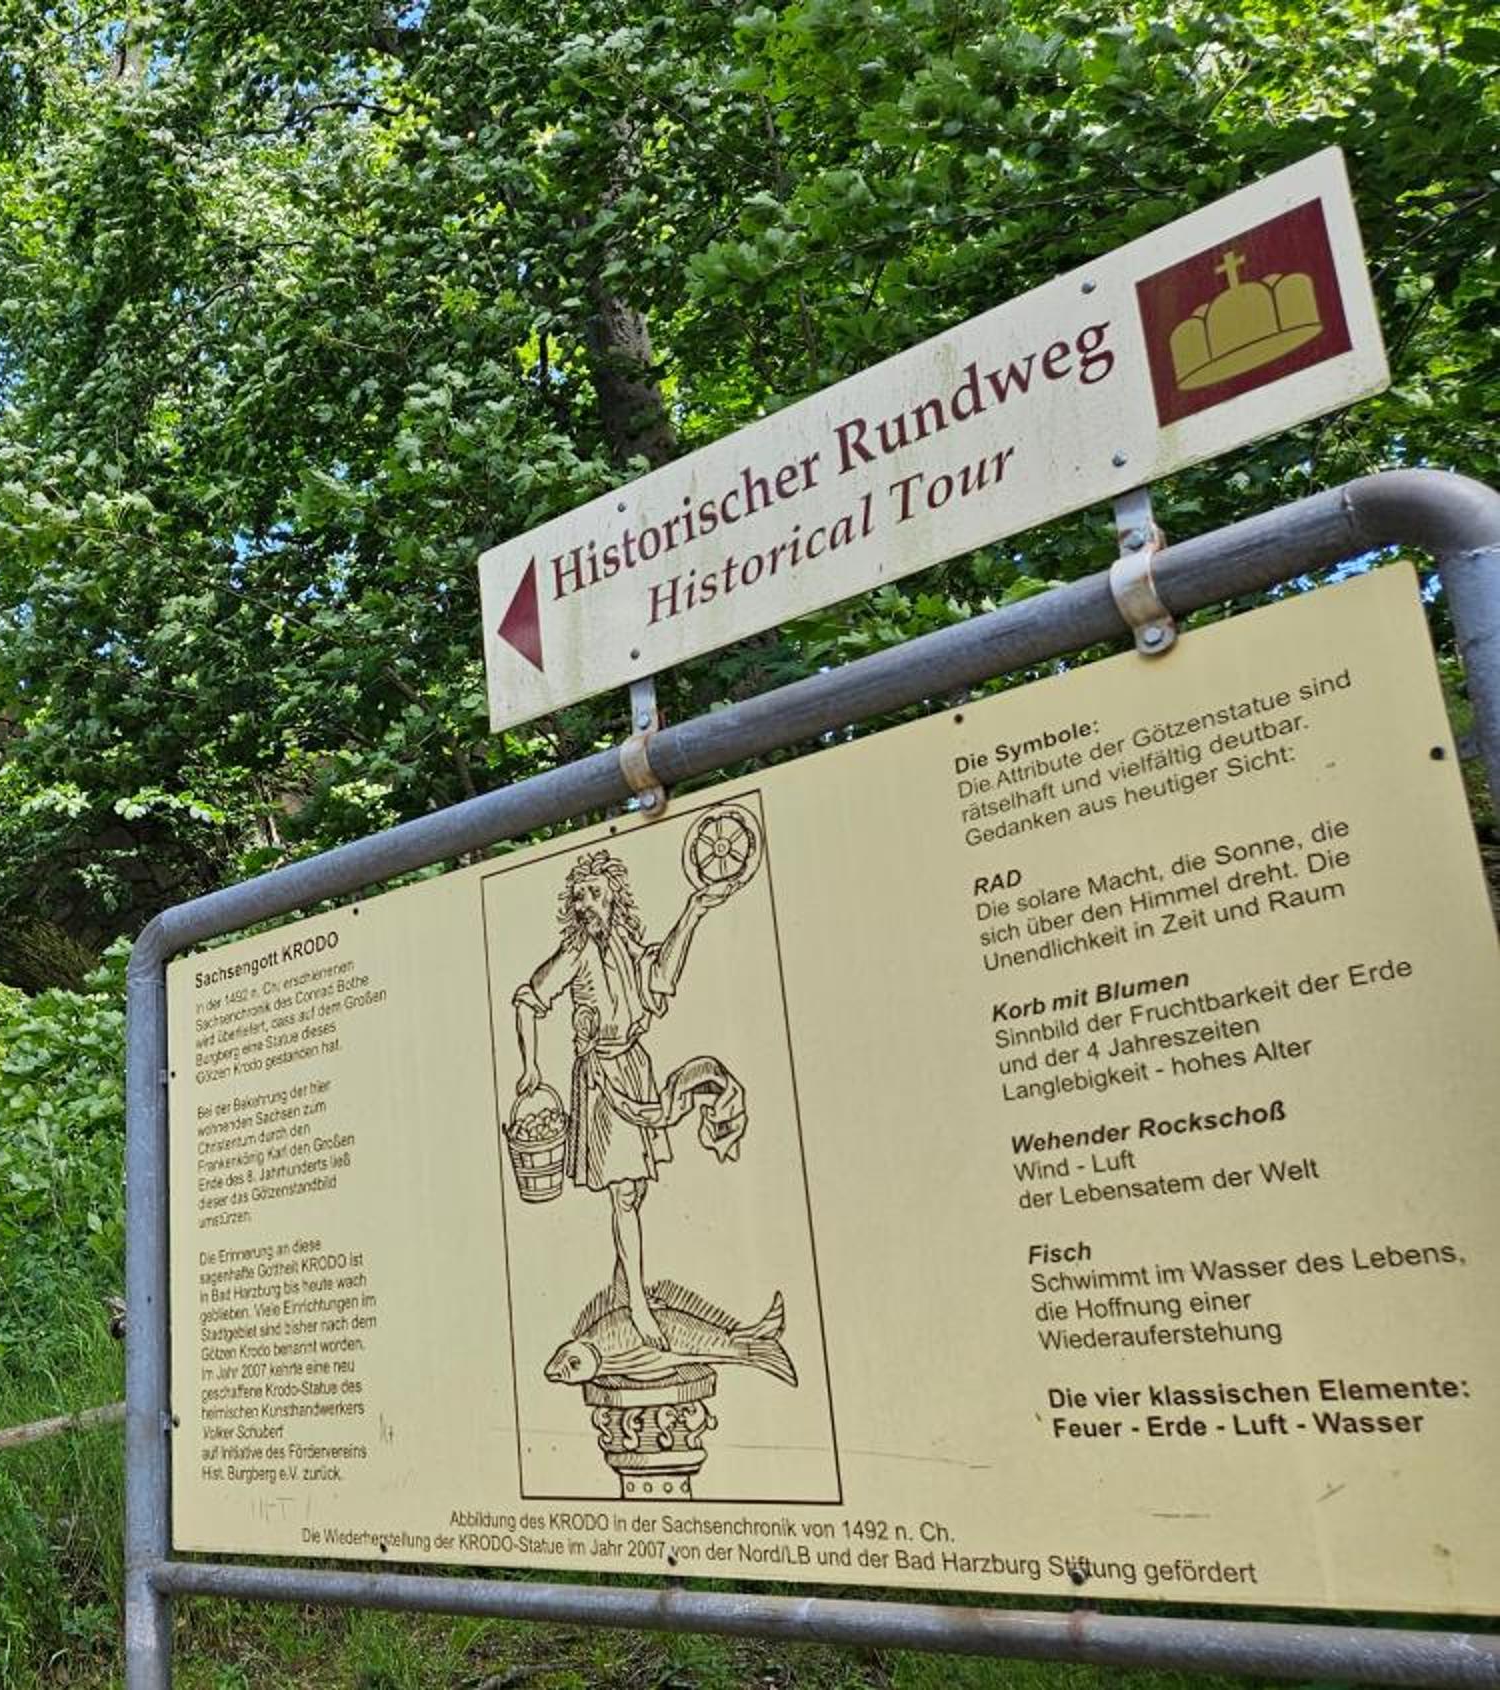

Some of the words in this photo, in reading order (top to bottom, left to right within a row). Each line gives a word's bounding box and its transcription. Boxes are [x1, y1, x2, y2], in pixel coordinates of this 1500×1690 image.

[549, 450, 820, 601] Historischer
[833, 320, 1115, 476] Rundweg
[647, 491, 874, 626] Historical
[889, 445, 1015, 524] Tour
[954, 753, 988, 775] Die
[995, 720, 1099, 763] Symbole:
[957, 777, 991, 799] Die
[996, 751, 1083, 789] Attribute
[1088, 738, 1125, 761] der
[1131, 691, 1291, 748] Götzenstatue
[1298, 668, 1351, 701] sind
[961, 781, 1057, 823] rätselhaft
[1061, 767, 1102, 795] und
[1107, 743, 1203, 782] vielfältig
[1208, 715, 1309, 755] deutbar.
[965, 807, 1071, 847] Gedanken
[1077, 795, 1117, 817] aus
[1123, 767, 1218, 805] heutiger
[1225, 745, 1295, 777] Sicht:
[973, 869, 1022, 896] RAD
[975, 900, 1010, 921] Die
[1016, 885, 1081, 912] solare
[1087, 863, 1164, 895] Macht,
[1171, 853, 1207, 876] die
[1214, 834, 1303, 865] Sonne,
[1311, 820, 1349, 843] die
[979, 922, 1021, 947] sich
[1026, 912, 1074, 936] über
[1080, 902, 1123, 923] den
[1129, 876, 1219, 913] Himmel
[1227, 860, 1298, 892] dreht.
[1306, 849, 1351, 874] Die
[983, 925, 1128, 971] Unendlichkeit
[1133, 921, 1155, 940] in
[1160, 908, 1208, 935] Zeit
[1213, 895, 1260, 923] und
[1267, 882, 1345, 912] Raum
[195, 950, 278, 988] Sachsengott
[282, 931, 338, 962] KRODO
[992, 996, 1046, 1023] Korb
[1051, 988, 1088, 1012] mit
[1095, 972, 1189, 1004] Blumen
[995, 1016, 1079, 1049] Sinnbild
[1086, 1012, 1123, 1033] der
[1129, 979, 1291, 1025] Fruchtbarkeit
[1297, 973, 1340, 995] der
[1347, 959, 1412, 987] Erde
[998, 1051, 1038, 1075] und
[1044, 1047, 1080, 1068] der
[1086, 1041, 1100, 1060] 4
[1107, 1018, 1260, 1057] Jahreszeiten
[1002, 1061, 1149, 1101] Langlebigkeit
[1170, 1050, 1247, 1076] hohes
[1253, 1039, 1312, 1064] Alter
[1011, 1124, 1131, 1154] Wehender
[1138, 1099, 1286, 1139] Rockschoß
[1013, 1156, 1070, 1182] Wind
[1091, 1148, 1137, 1173] Luft
[1018, 1189, 1053, 1209] der
[1059, 1175, 1205, 1205] Lebensatem
[1211, 1167, 1253, 1189] der
[1258, 1157, 1320, 1184] Welt
[1028, 1240, 1091, 1265] Fisch
[1031, 1266, 1151, 1293] Schwimmt
[1155, 1263, 1185, 1284] im
[1189, 1258, 1287, 1281] Wasser
[1295, 1251, 1345, 1275] des
[1351, 1245, 1466, 1270] Lebens,
[361, 1291, 376, 1307] im
[1035, 1300, 1069, 1322] die
[1074, 1296, 1182, 1320] Hoffnung
[1189, 1291, 1252, 1313] einer
[1037, 1320, 1283, 1350] Wiederauferstehung
[1047, 1387, 1087, 1409] Die
[1093, 1386, 1141, 1407] vier
[1148, 1381, 1310, 1407] klassischen
[1317, 1376, 1470, 1401] Elemente:
[1052, 1417, 1122, 1438] Feuer
[1146, 1415, 1207, 1437] Erde
[1232, 1412, 1289, 1436] Luft
[1311, 1411, 1424, 1434] Wasser
[449, 1510, 516, 1533] Abbildung
[519, 1513, 546, 1530] des
[548, 1512, 609, 1531] KRODO
[613, 1513, 627, 1532] in
[631, 1514, 657, 1533] der
[661, 1514, 797, 1537] Sachsenchronik
[801, 1523, 835, 1539] von
[841, 1519, 889, 1541] 1492
[894, 1525, 914, 1542] n.
[919, 1521, 955, 1543] Ch.
[301, 1527, 321, 1544] Die
[433, 1534, 455, 1549] der
[458, 1533, 564, 1555] KRODO-Statue
[567, 1537, 586, 1555] im
[589, 1538, 623, 1556] Jahr
[627, 1539, 665, 1559] 2007
[705, 1541, 734, 1561] der
[737, 1543, 811, 1565] Nord/LB
[816, 1547, 852, 1567] und
[856, 1548, 889, 1569] der
[894, 1548, 936, 1571] Bad
[941, 1551, 1041, 1580] Harzburg
[1047, 1554, 1137, 1584] Stiftung
[1143, 1559, 1258, 1585] gefördert
